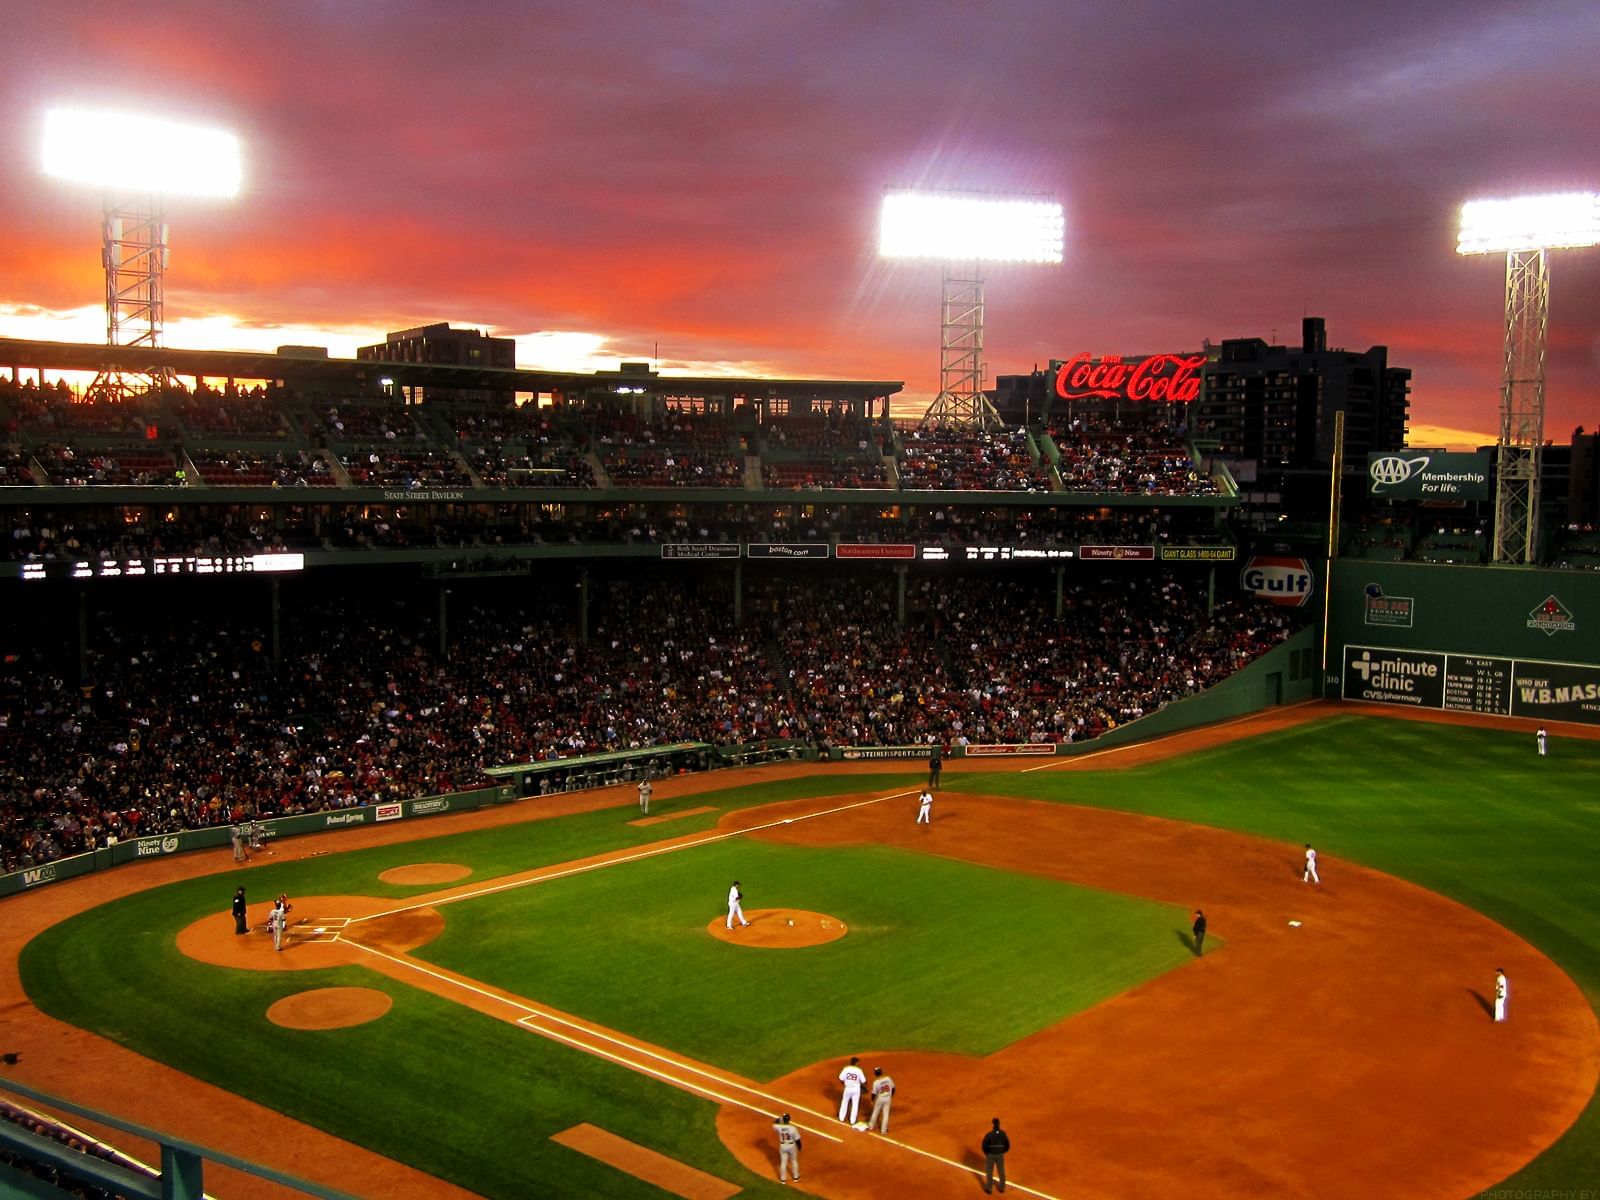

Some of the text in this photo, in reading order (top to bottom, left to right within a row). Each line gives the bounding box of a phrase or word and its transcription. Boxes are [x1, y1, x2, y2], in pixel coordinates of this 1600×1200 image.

[1375, 457, 1407, 482] AAA
[1421, 472, 1484, 483] Membership
[1421, 484, 1439, 492] For
[1245, 570, 1308, 592] Gulf
[1381, 658, 1438, 677] minute
[1326, 676, 1339, 684] 310
[1372, 673, 1414, 691] clinic
[1362, 689, 1422, 703] CVS/pharmacy
[138, 839, 161, 847] Ninety
[138, 846, 160, 855] Nine
